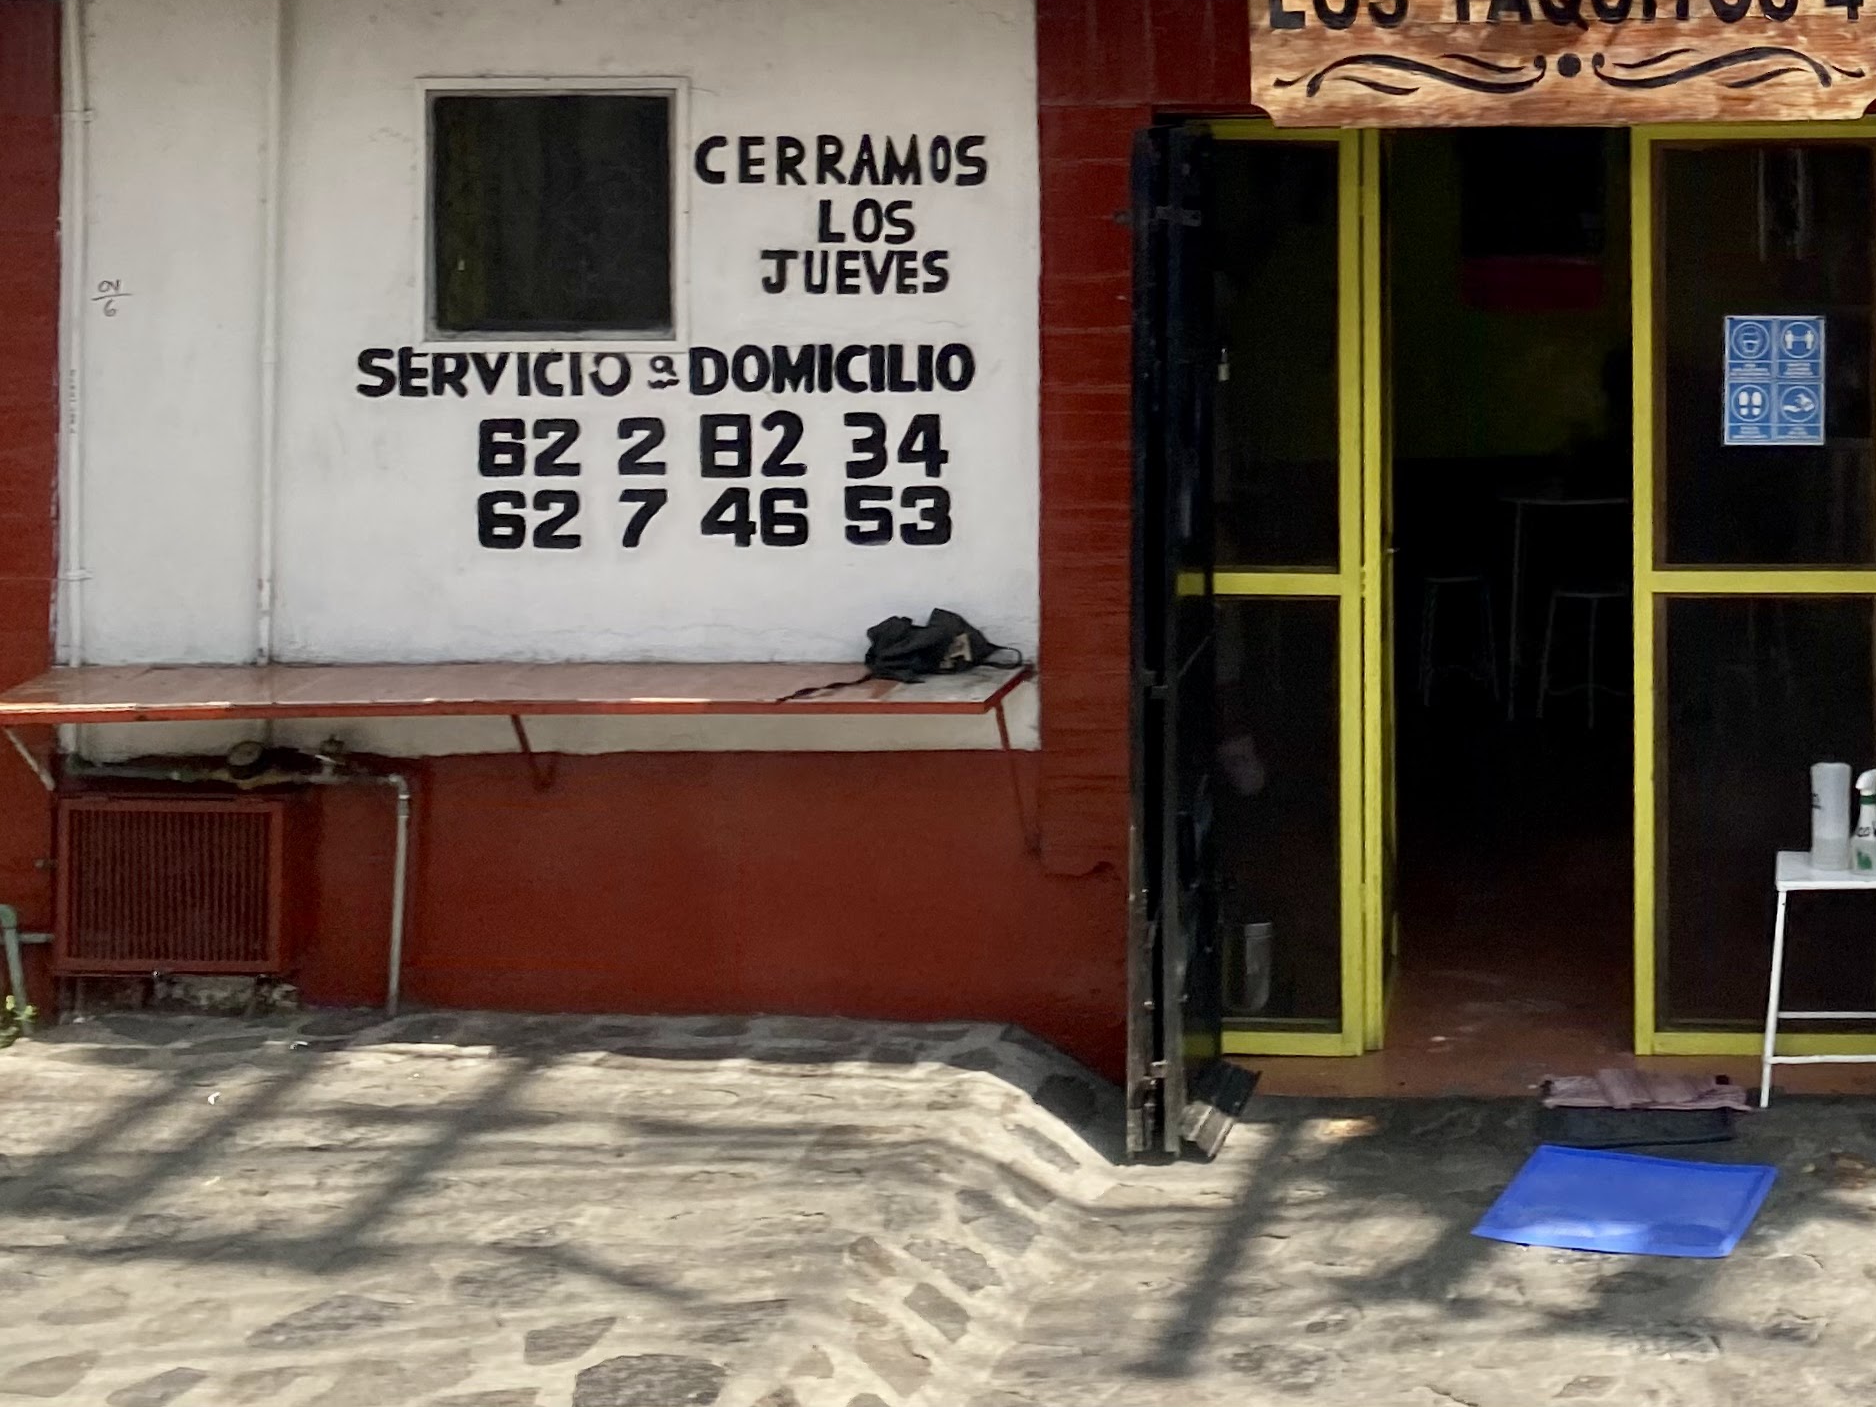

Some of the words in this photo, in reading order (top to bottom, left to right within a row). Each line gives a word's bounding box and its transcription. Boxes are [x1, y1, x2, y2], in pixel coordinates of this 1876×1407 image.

[694, 134, 988, 187] CERRAMOS
[817, 197, 916, 245] LOS
[760, 249, 950, 295] JUEVES
[356, 346, 632, 398] SERVICIO
[688, 342, 976, 396] DOMICILIO
[477, 417, 582, 478] 62
[617, 416, 667, 476] 2
[699, 409, 809, 479] 82
[843, 411, 950, 480] 34
[477, 489, 582, 550] 62
[618, 488, 668, 548] 7
[700, 486, 809, 548] 46
[844, 484, 953, 547] 53
